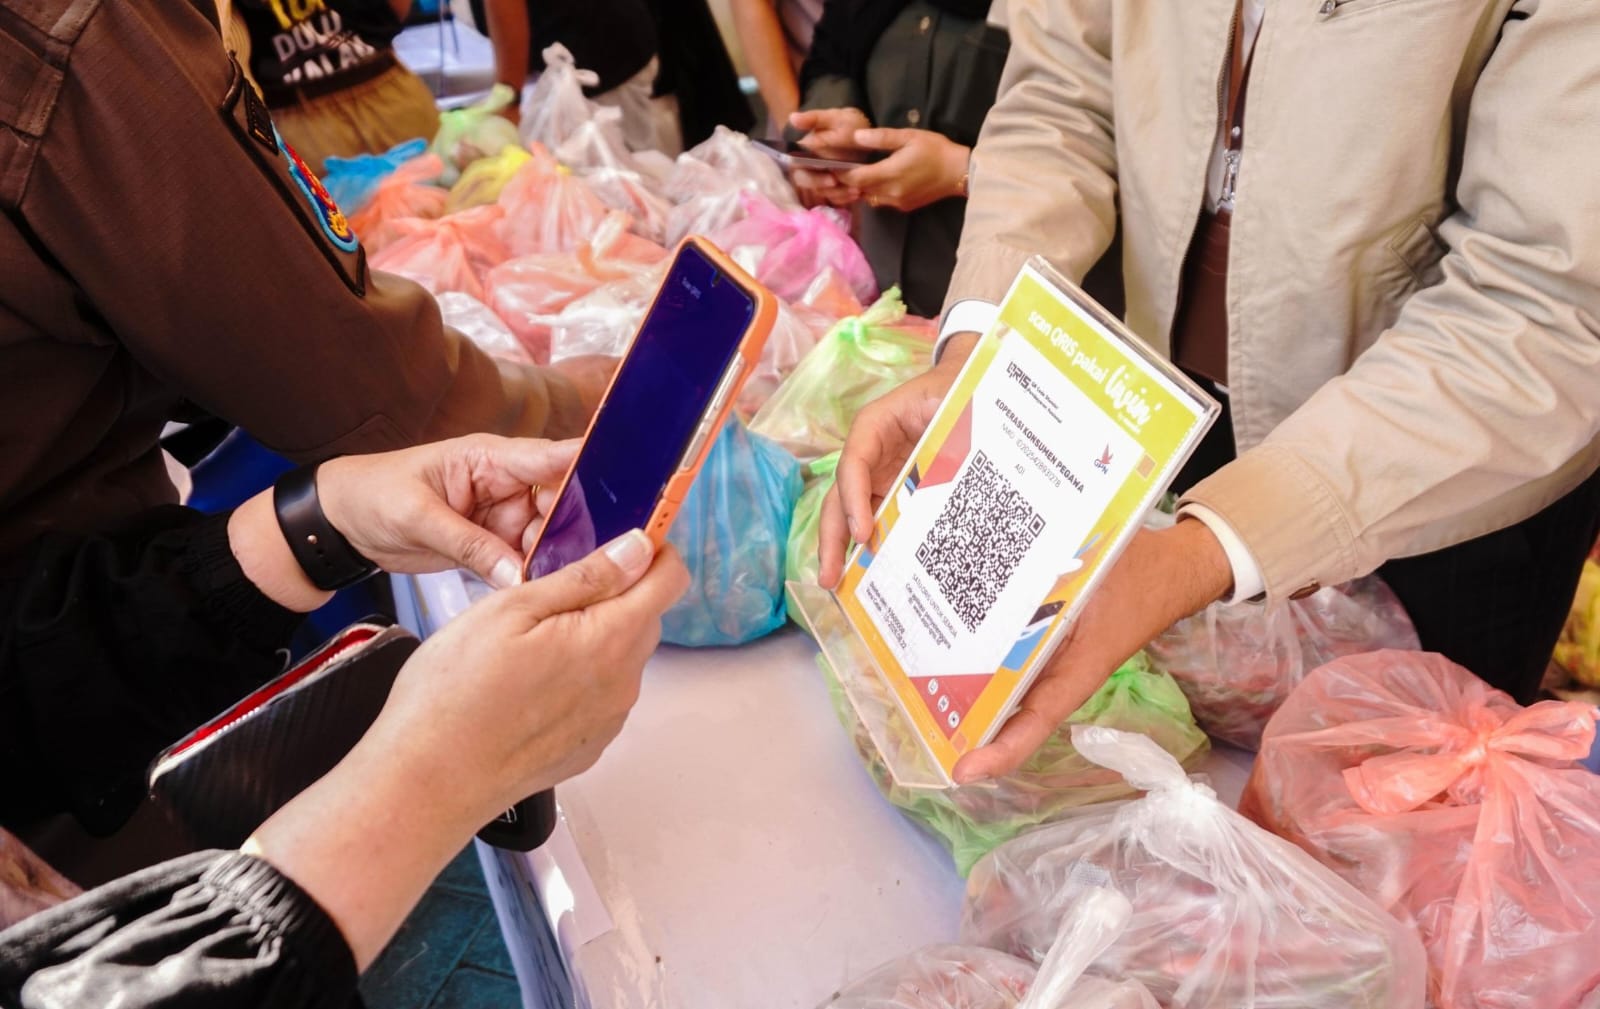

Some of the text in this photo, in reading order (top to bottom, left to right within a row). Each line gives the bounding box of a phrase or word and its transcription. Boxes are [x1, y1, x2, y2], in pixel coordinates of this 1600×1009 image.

[1028, 311, 1052, 337] scan
[1050, 327, 1078, 357] QRIS
[1072, 351, 1109, 385] pakai
[1006, 361, 1031, 389] QRIS
[994, 397, 1084, 494] KOPERASI KONSUMEN PEGAWA
[1093, 458, 1109, 475] GPN
